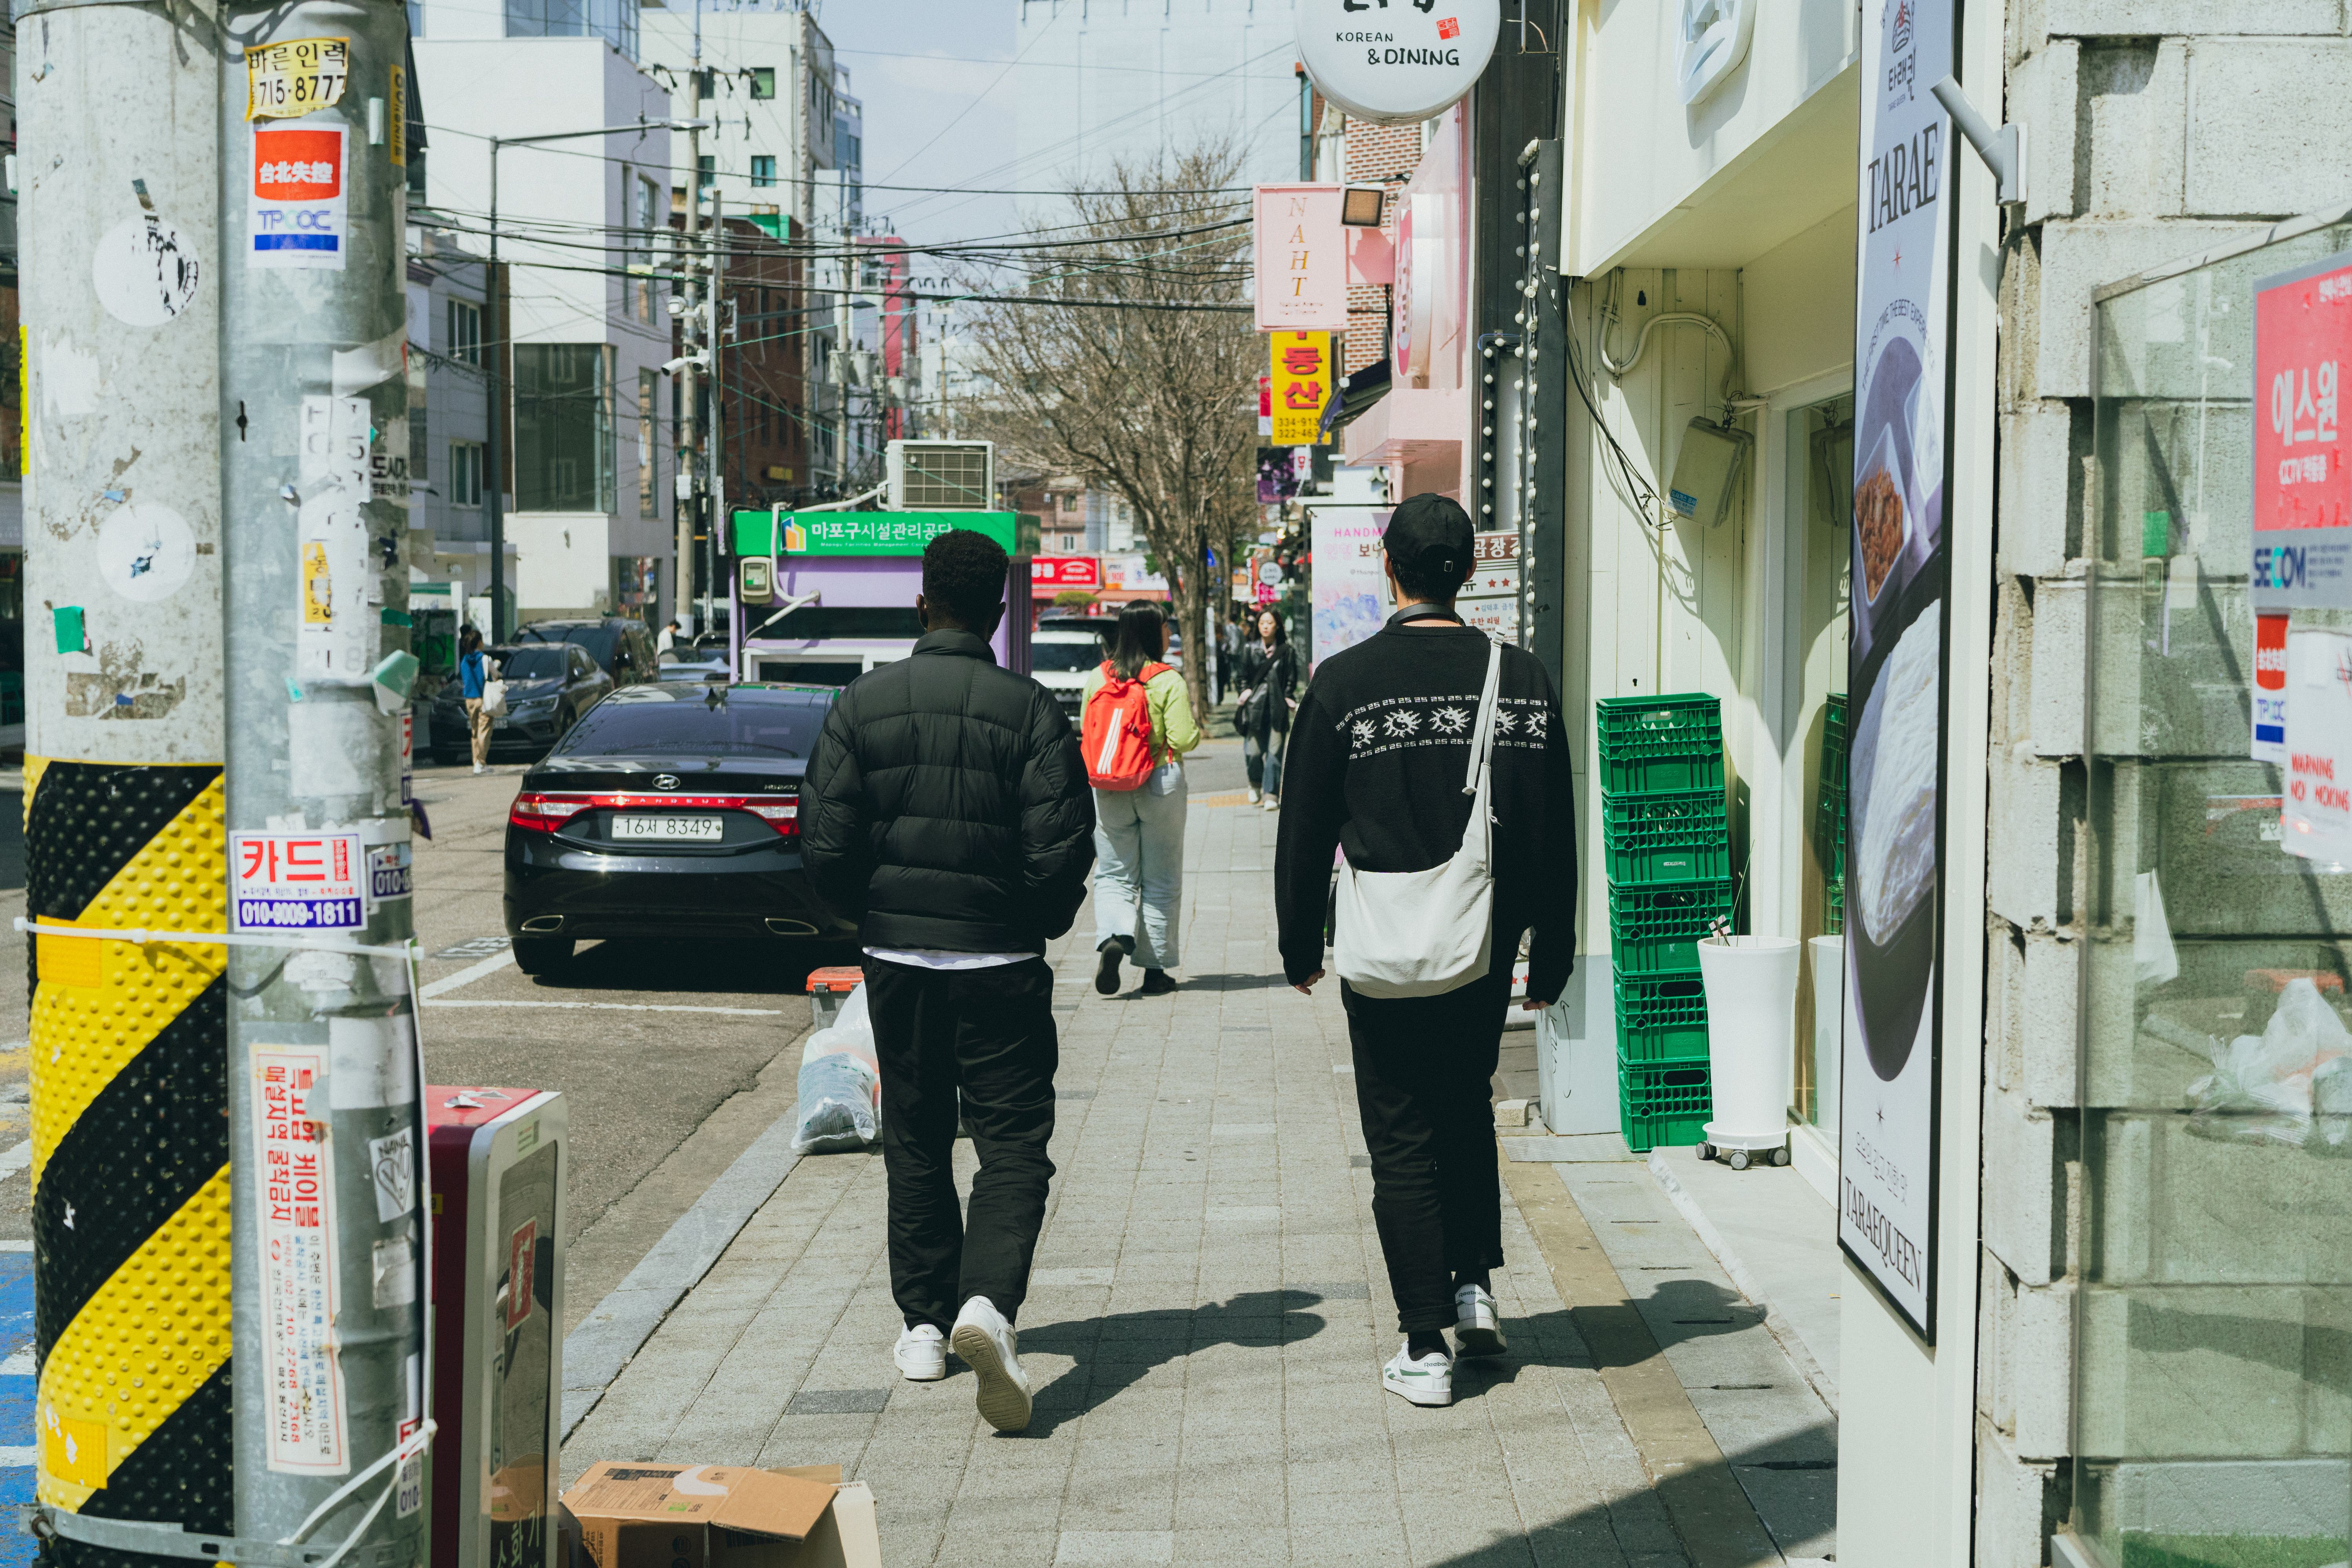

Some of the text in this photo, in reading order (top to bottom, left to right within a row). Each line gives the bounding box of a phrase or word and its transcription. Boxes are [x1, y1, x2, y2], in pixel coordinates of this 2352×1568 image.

[1336, 32, 1393, 42] KOREAN
[249, 42, 346, 73] 바른인력
[1867, 121, 1938, 234] TARAE
[1282, 332, 1322, 410] 동산
[2272, 361, 2338, 447] 에스원
[1278, 417, 1319, 427] 334-913
[1334, 527, 1387, 537] HANDM
[2253, 546, 2307, 590] SECOM
[1470, 616, 1500, 626] 무한 리필
[2291, 752, 2335, 781] WARNING
[2290, 780, 2307, 802] NO
[624, 818, 712, 836] 16서 8349
[241, 840, 325, 883] 카드
[293, 1153, 319, 1228] 케이블
[1845, 1176, 1922, 1294] TARAEQUEEN
[1458, 1290, 1483, 1298] Reebok
